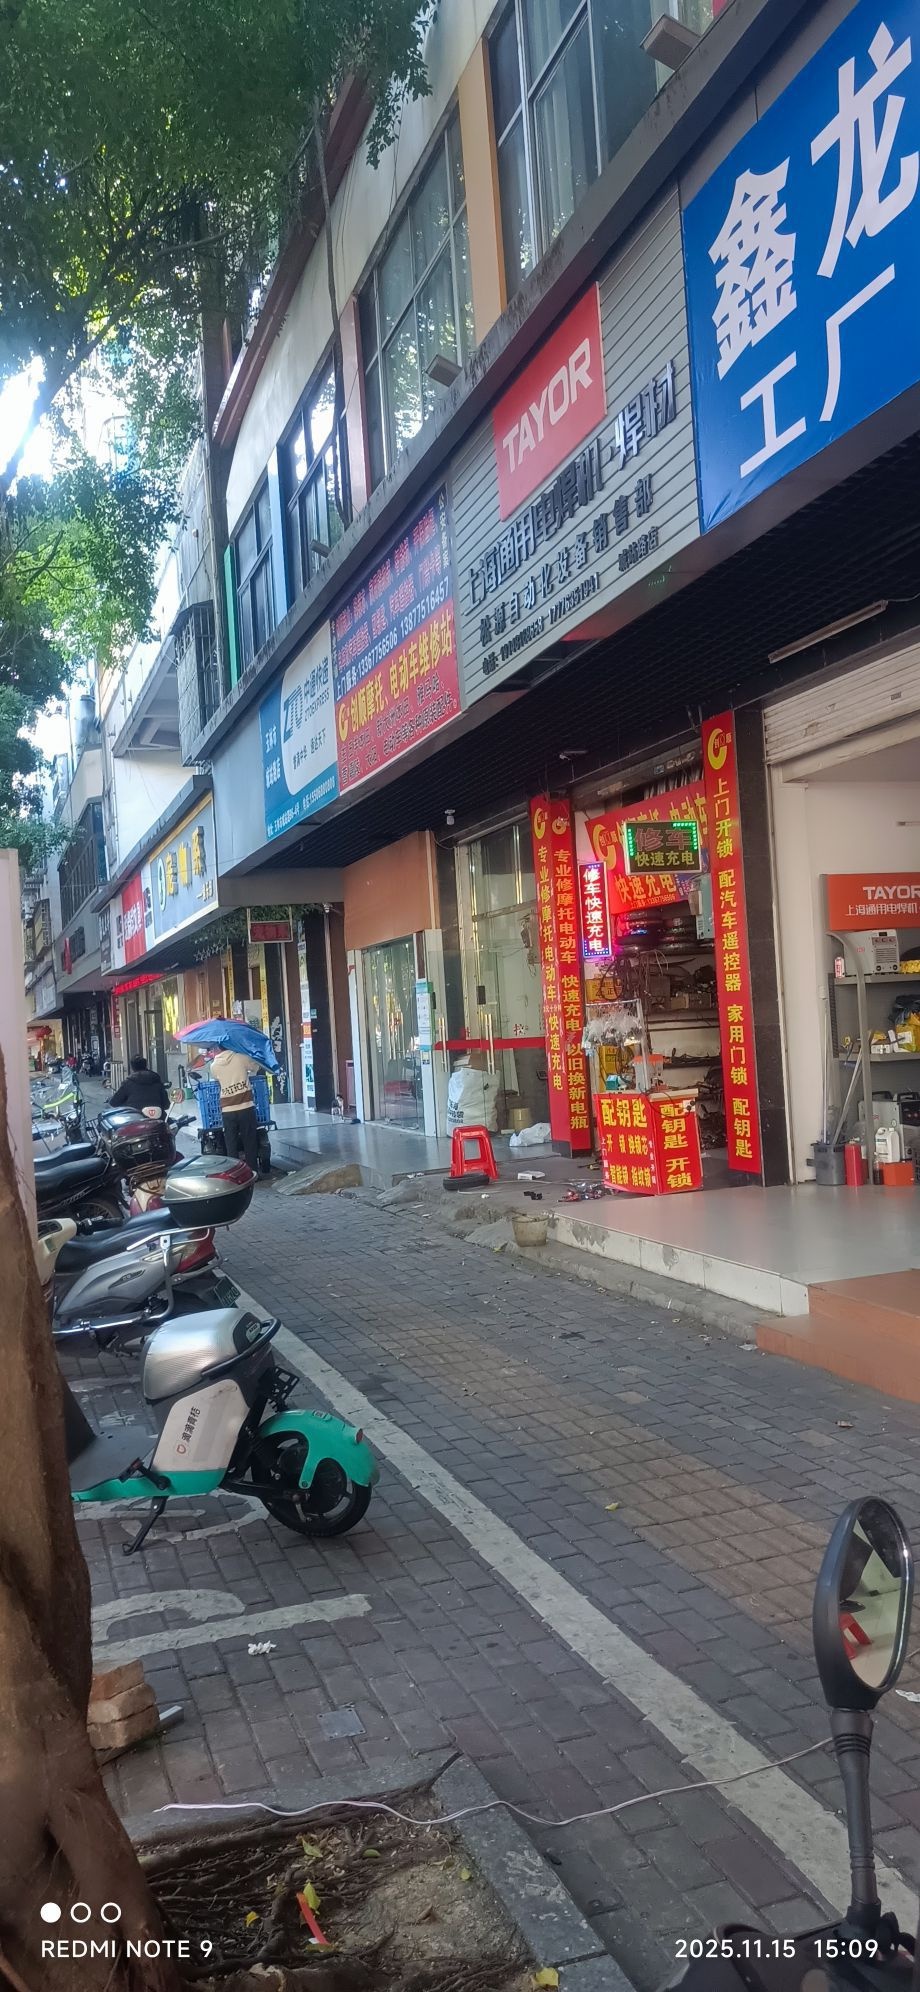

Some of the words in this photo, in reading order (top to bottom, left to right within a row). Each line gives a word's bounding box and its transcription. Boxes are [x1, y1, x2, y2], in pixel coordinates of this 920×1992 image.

[708, 22, 919, 381] 鑫龙
[502, 337, 593, 474] TAYOR
[740, 263, 895, 479] 工厂
[400, 575, 449, 639] 13877516457
[634, 827, 692, 851] 修车
[634, 850, 695, 868] 快速充电
[713, 778, 734, 859] 上门开锁
[553, 849, 577, 964] 专业修摩托电动车
[583, 868, 605, 953] 修车快速充电
[718, 869, 742, 992] 配汽车遥控器
[862, 884, 920, 901] TAYOR
[537, 845, 557, 1002] 专业修摩托电动车
[548, 1013, 564, 1091] 快速充电
[561, 975, 582, 1032] 快速充电
[727, 1004, 748, 1086] 家用门锁
[566, 1043, 589, 1130] 以旧换新电瓶
[600, 1098, 648, 1128] 配钥匙
[659, 1102, 689, 1150] 配钥匙
[732, 1098, 753, 1159] 配钥匙
[665, 1156, 693, 1189] 开锁
